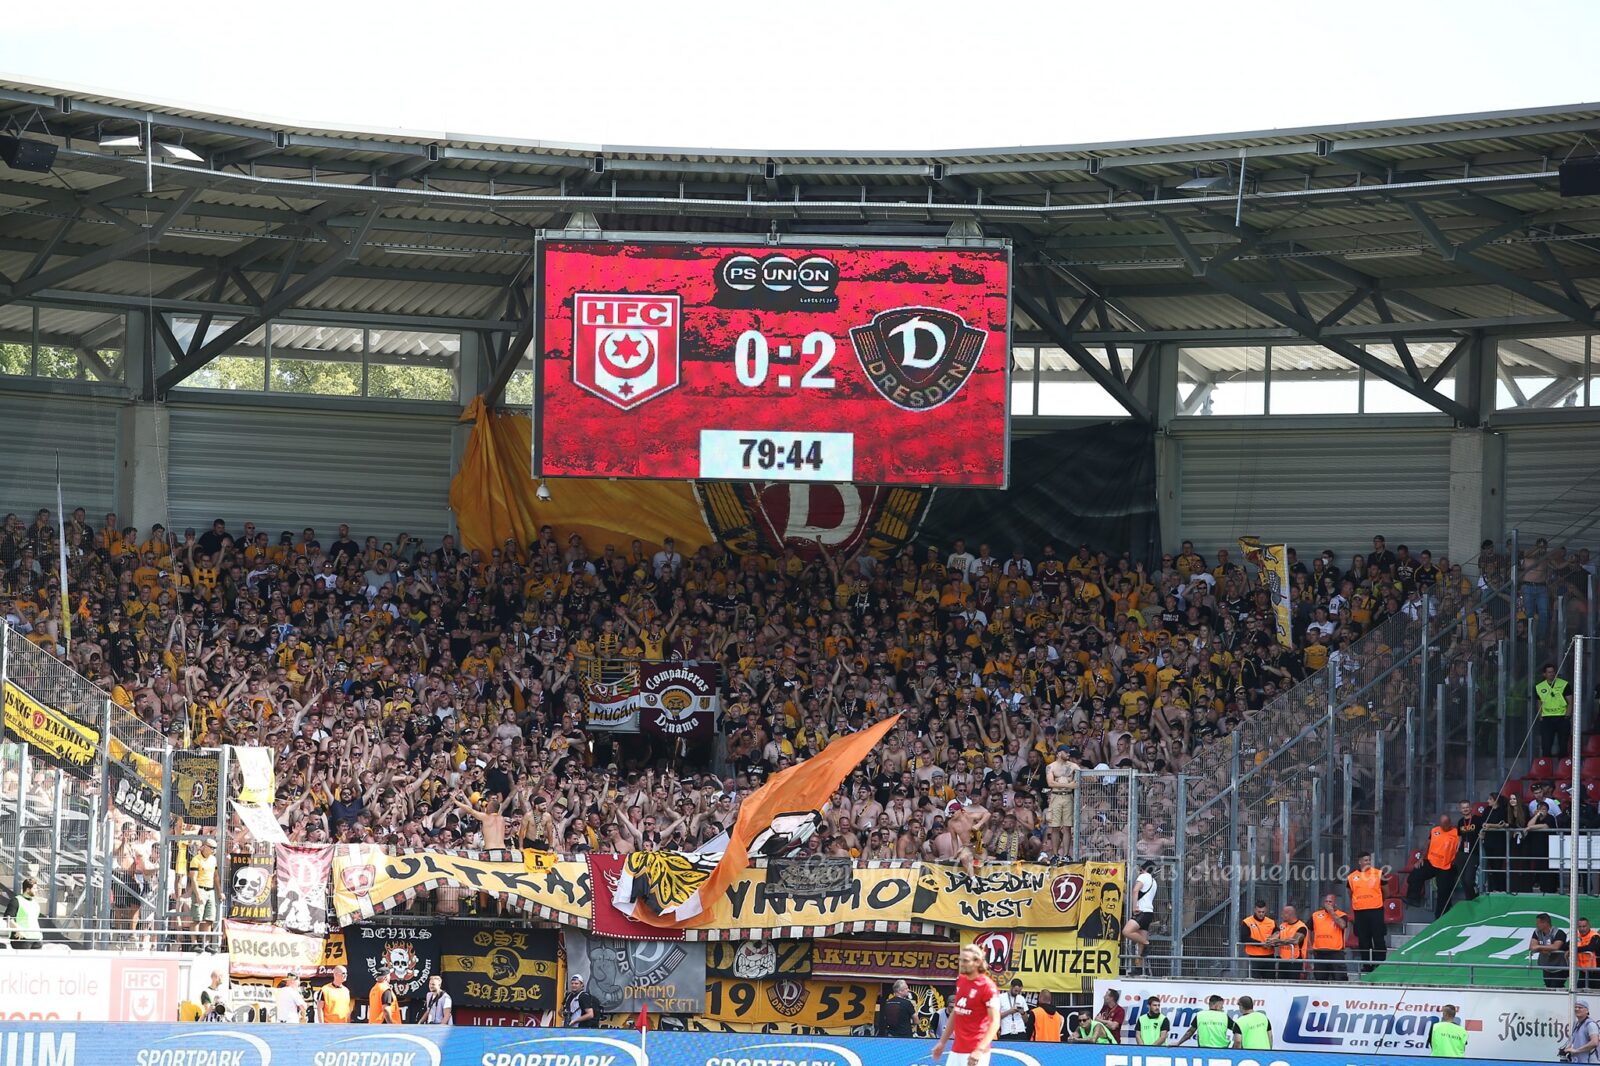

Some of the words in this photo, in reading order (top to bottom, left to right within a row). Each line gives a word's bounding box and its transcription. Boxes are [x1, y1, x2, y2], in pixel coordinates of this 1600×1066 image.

[730, 268, 757, 280] PS
[763, 268, 829, 281] UNION
[586, 302, 668, 324] HFC
[888, 315, 946, 369] D
[735, 329, 836, 389] 0:2
[868, 360, 968, 405] DRESDEN
[739, 439, 824, 470] 79:44
[645, 667, 710, 692] Compañeros
[534, 854, 544, 867] 6
[945, 870, 1045, 896] DRESDEN
[958, 898, 1033, 923] WEST
[360, 927, 432, 939] DEVILS
[232, 939, 300, 958] BRIGADE
[812, 946, 933, 969] AKTIVIST
[57, 972, 99, 996] tolle
[127, 974, 161, 987] HFC
[464, 980, 542, 1003] BANDE
[623, 984, 676, 1000] DYNAMO
[706, 982, 756, 1017] 19
[817, 985, 867, 1021] 53
[770, 1000, 805, 1017] DRESDEN
[1349, 1039, 1371, 1048] an
[1374, 1035, 1400, 1048] der
[136, 1049, 245, 1066] SPORTPARK
[314, 1051, 416, 1066] SPORTPARK
